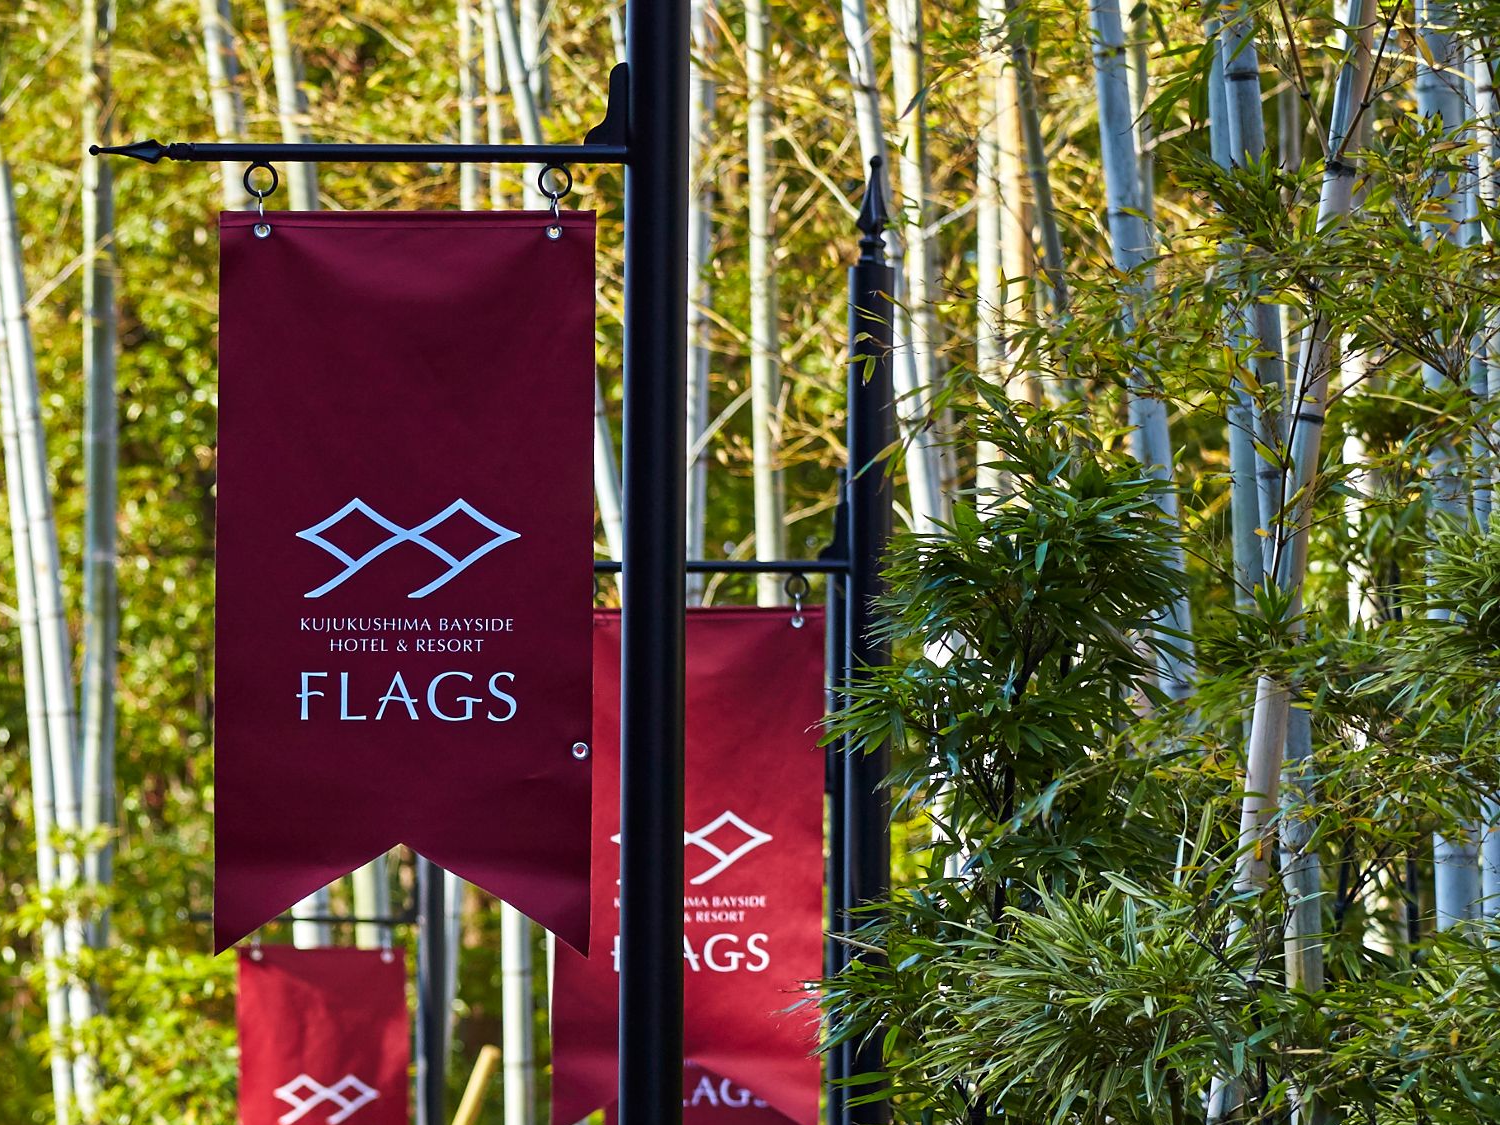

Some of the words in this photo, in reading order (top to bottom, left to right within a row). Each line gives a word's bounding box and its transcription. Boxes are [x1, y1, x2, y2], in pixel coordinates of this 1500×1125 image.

[300, 617, 432, 633] KUJUKUSHIMA
[439, 618, 514, 632] BAYSIDE
[330, 638, 389, 652] HOTEL
[396, 638, 408, 652] &
[416, 638, 485, 652] RESORT
[296, 670, 518, 722] FLAGS
[711, 895, 768, 908] BAYSIDE
[695, 911, 746, 923] RESORT
